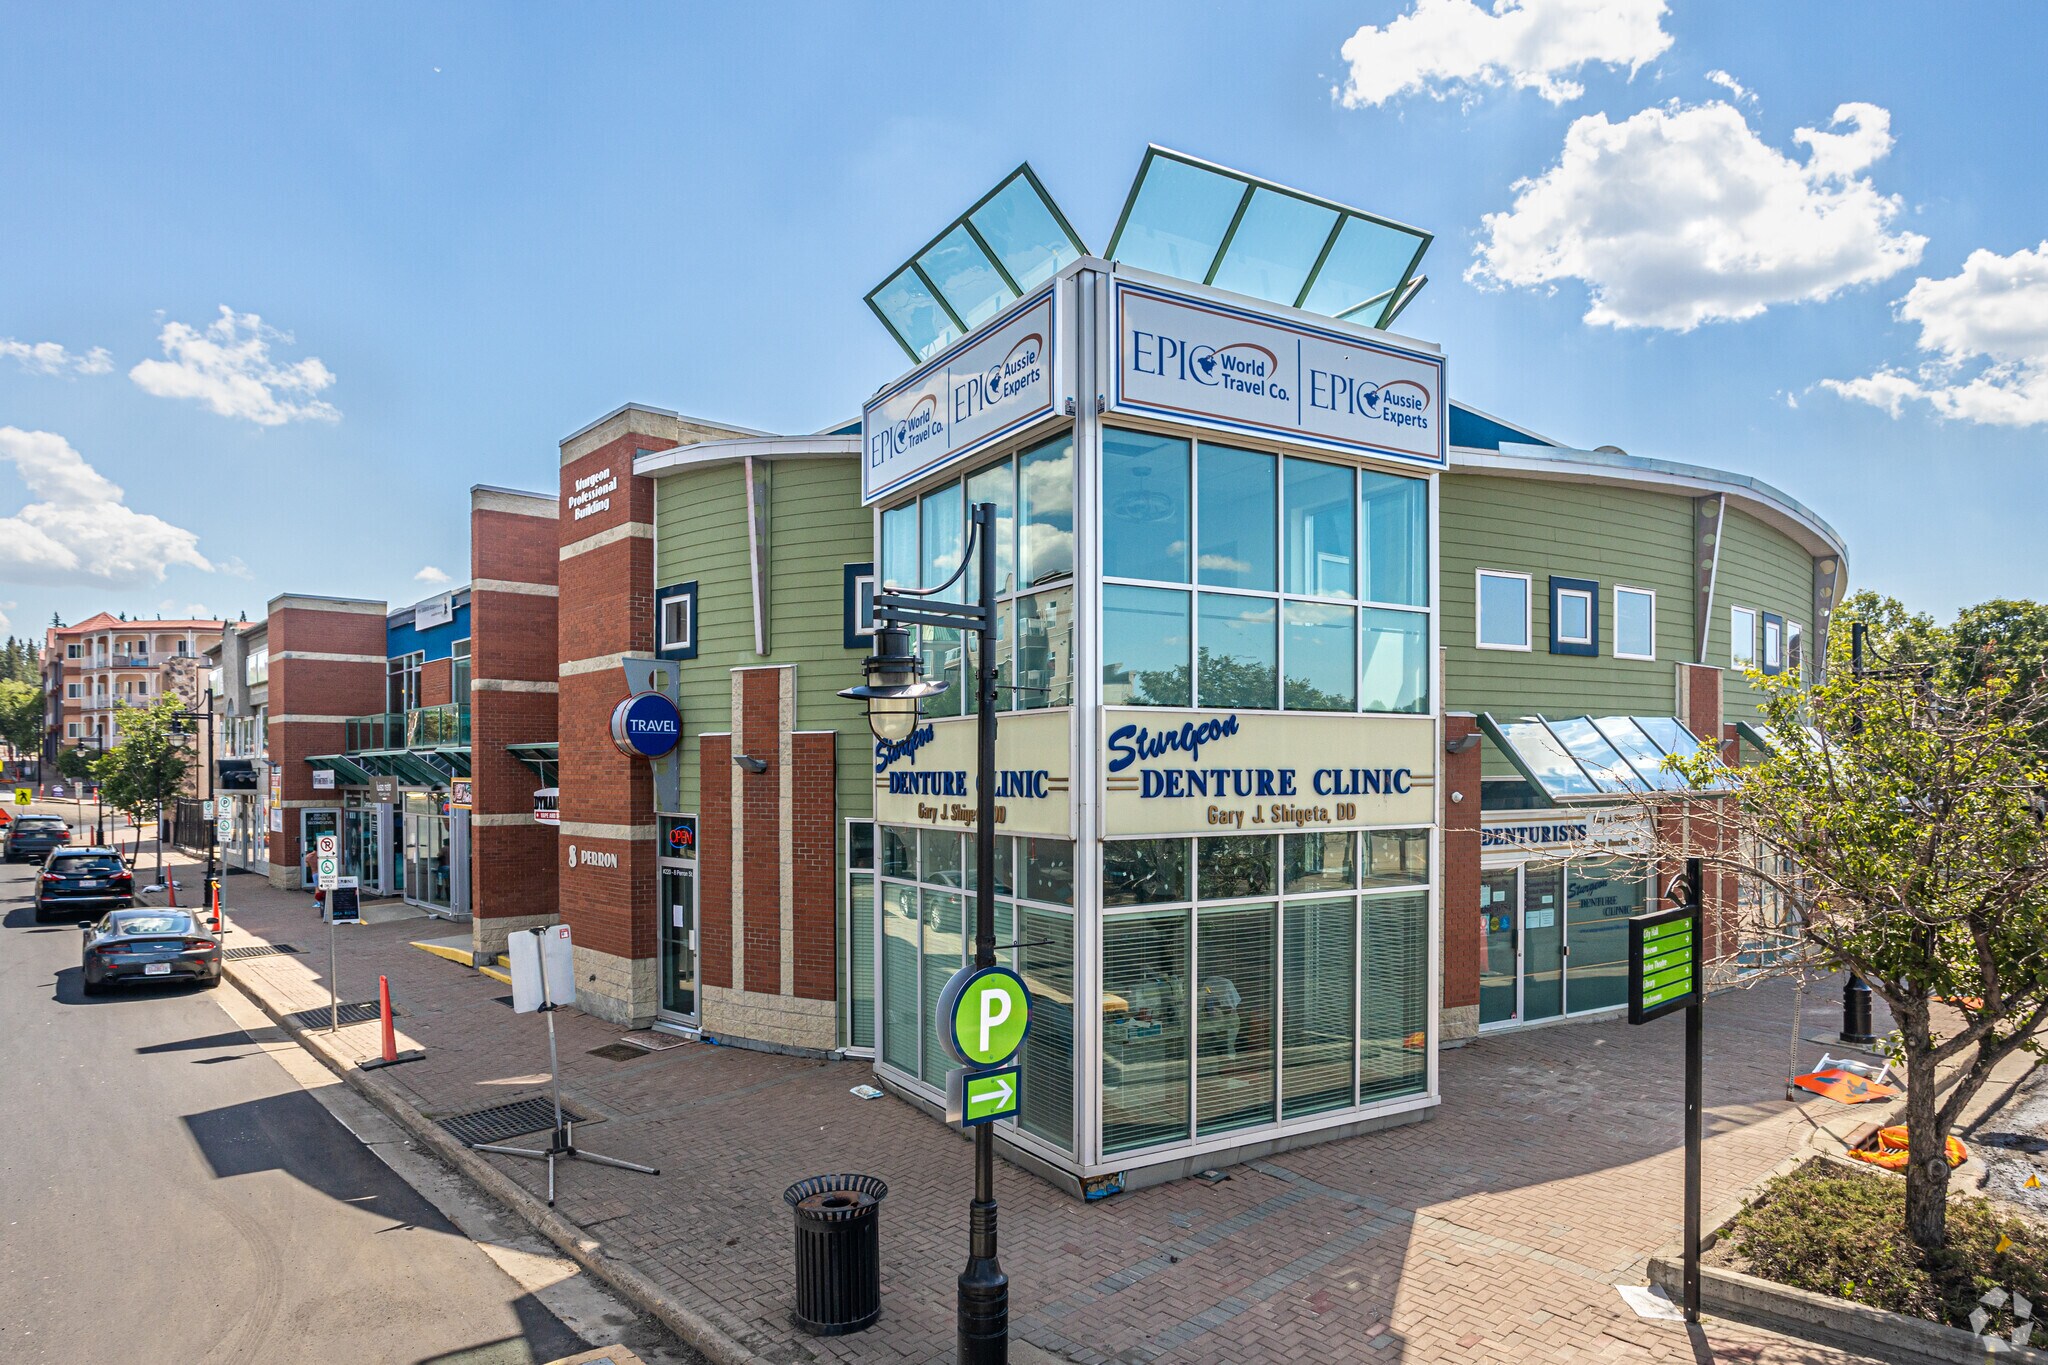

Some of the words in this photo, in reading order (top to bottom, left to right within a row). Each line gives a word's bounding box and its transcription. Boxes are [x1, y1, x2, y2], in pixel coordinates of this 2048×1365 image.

[1003, 350, 1036, 379] Aussie
[1132, 330, 1219, 386] EPIC
[1220, 353, 1265, 377] World
[954, 364, 1003, 424] EPIC
[1003, 367, 1041, 398] Experts
[1221, 373, 1265, 397] Travel
[1269, 383, 1290, 401] Co.
[1309, 369, 1382, 419] EPIC
[1383, 389, 1423, 411] Aussie
[907, 407, 930, 433] World
[1383, 406, 1428, 429] Experts
[871, 419, 908, 469] EPIC
[908, 424, 931, 448] Travel
[931, 421, 944, 436] Co.
[568, 476, 617, 509] Professional
[575, 468, 610, 492] Sturgeon
[574, 498, 610, 521] Building
[630, 719, 677, 732] TRAVEL
[1108, 714, 1239, 773] Sturgeon
[889, 771, 967, 796] DENTURE
[1140, 768, 1297, 798] DENTURE
[1313, 768, 1412, 796] CLINIC
[918, 802, 938, 823] Gary
[940, 803, 949, 820] J.
[1208, 805, 1245, 829] Gary
[1252, 804, 1265, 823] J.
[1271, 803, 1332, 828] Shigeta,
[1337, 803, 1357, 821] DD
[669, 829, 693, 845] OPEN
[1481, 824, 1588, 847] DENTURISTS
[568, 844, 577, 868] 8
[581, 849, 618, 869] PERRON
[1567, 879, 1608, 899] Sturgeon
[1580, 896, 1618, 908] DENTURE
[1603, 905, 1632, 917] CLINIC
[979, 988, 1012, 1053] P
